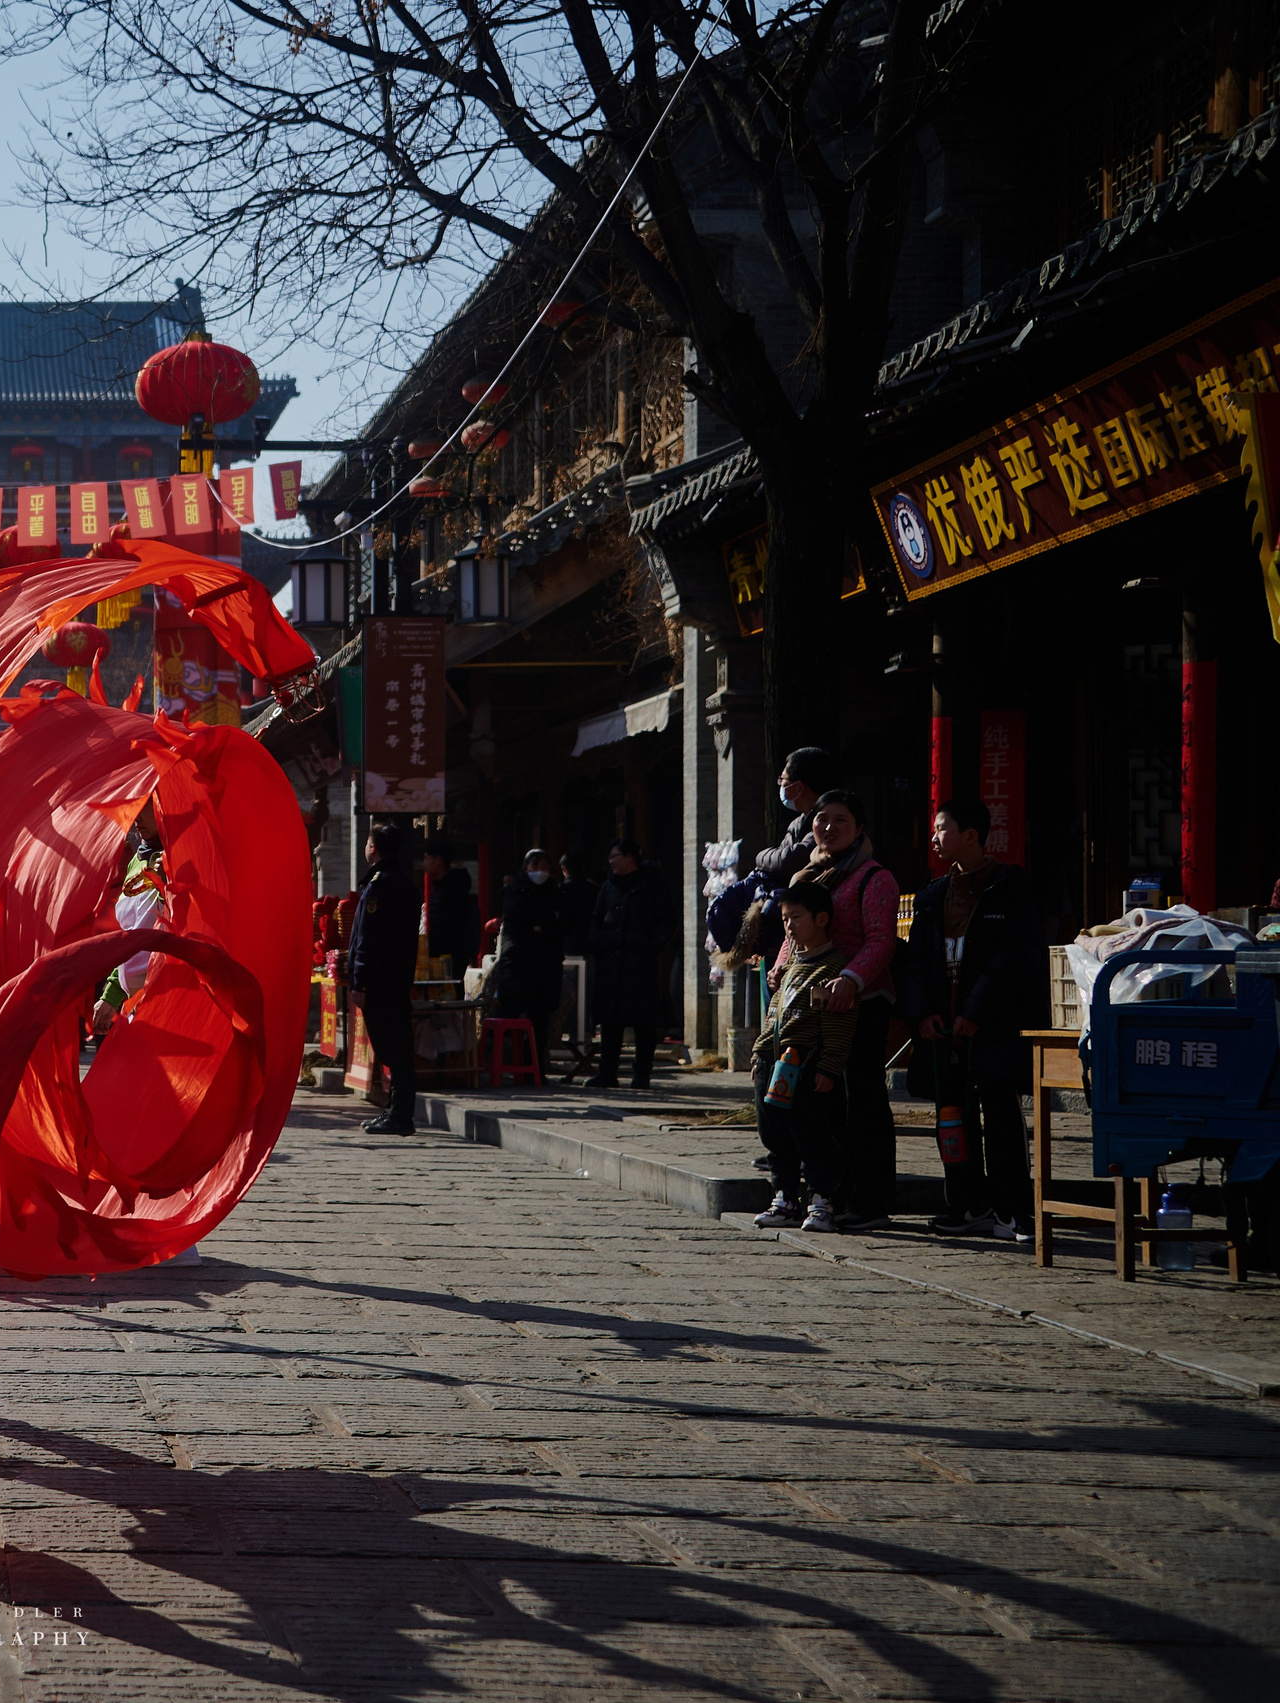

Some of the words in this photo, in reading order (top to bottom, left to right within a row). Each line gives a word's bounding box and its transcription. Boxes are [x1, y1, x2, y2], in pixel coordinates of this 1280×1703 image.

[924, 344, 1280, 566] 优俄严选国际连锁超
[983, 725, 1011, 855] 纯手工姜糖
[1135, 1039, 1218, 1068] 鹏程
